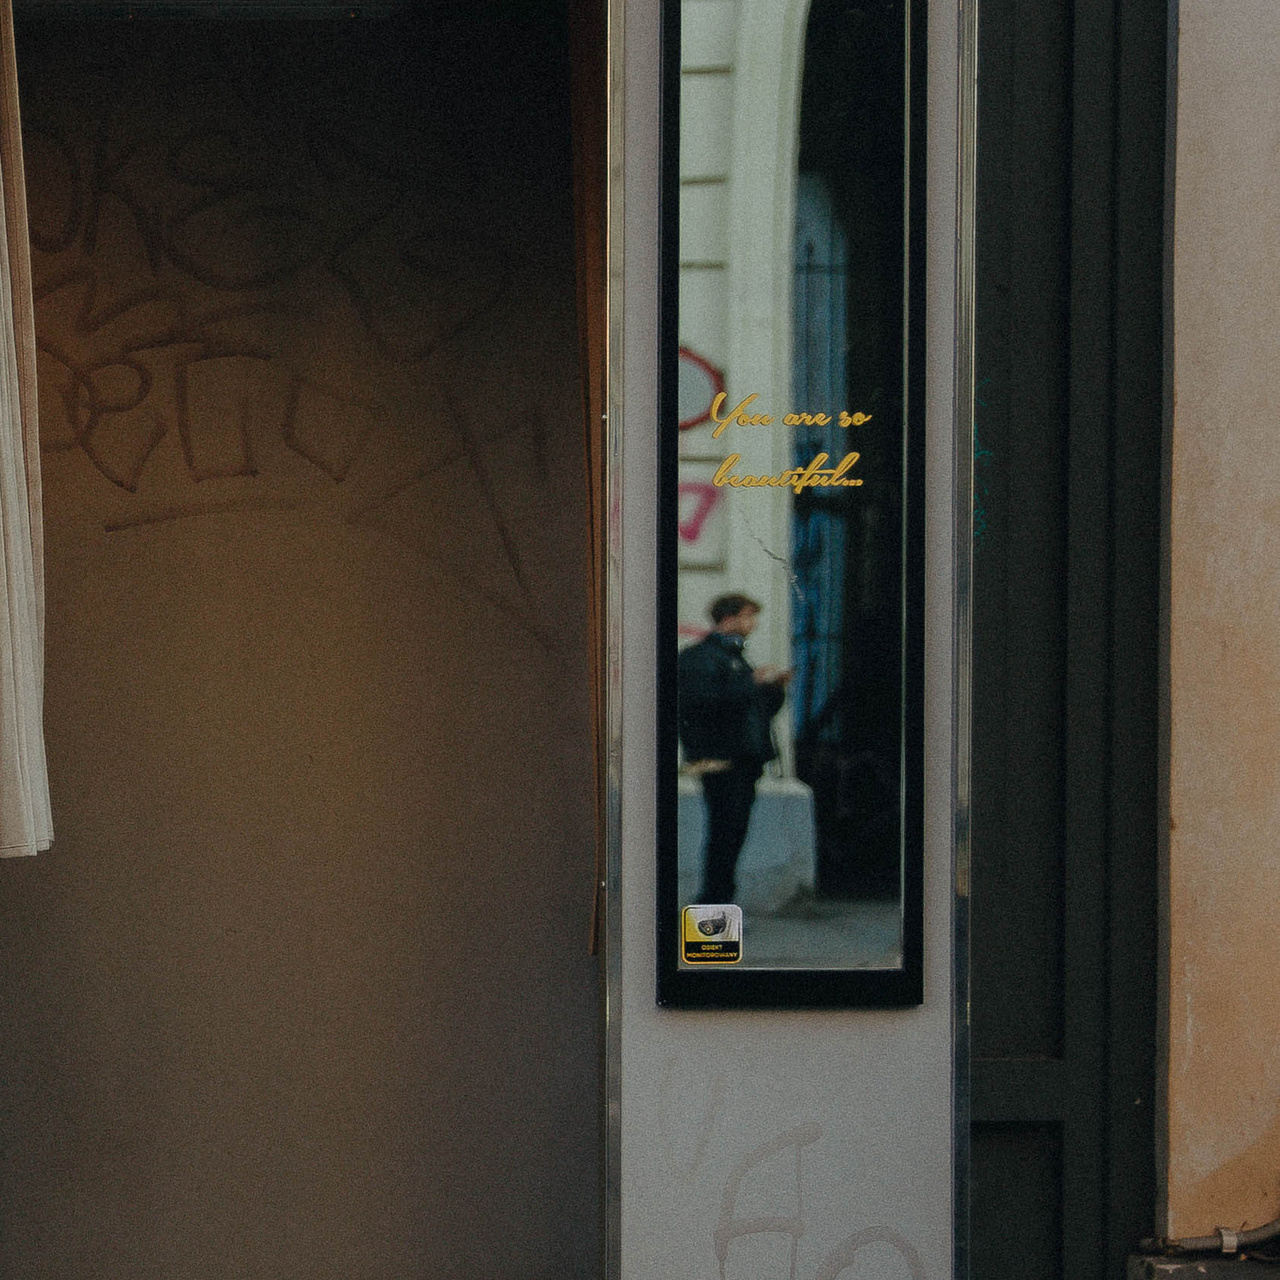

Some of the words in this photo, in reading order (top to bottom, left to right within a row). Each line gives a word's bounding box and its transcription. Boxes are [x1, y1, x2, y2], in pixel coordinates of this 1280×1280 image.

[710, 392, 774, 439] You
[782, 411, 832, 426] are
[839, 411, 872, 428] so
